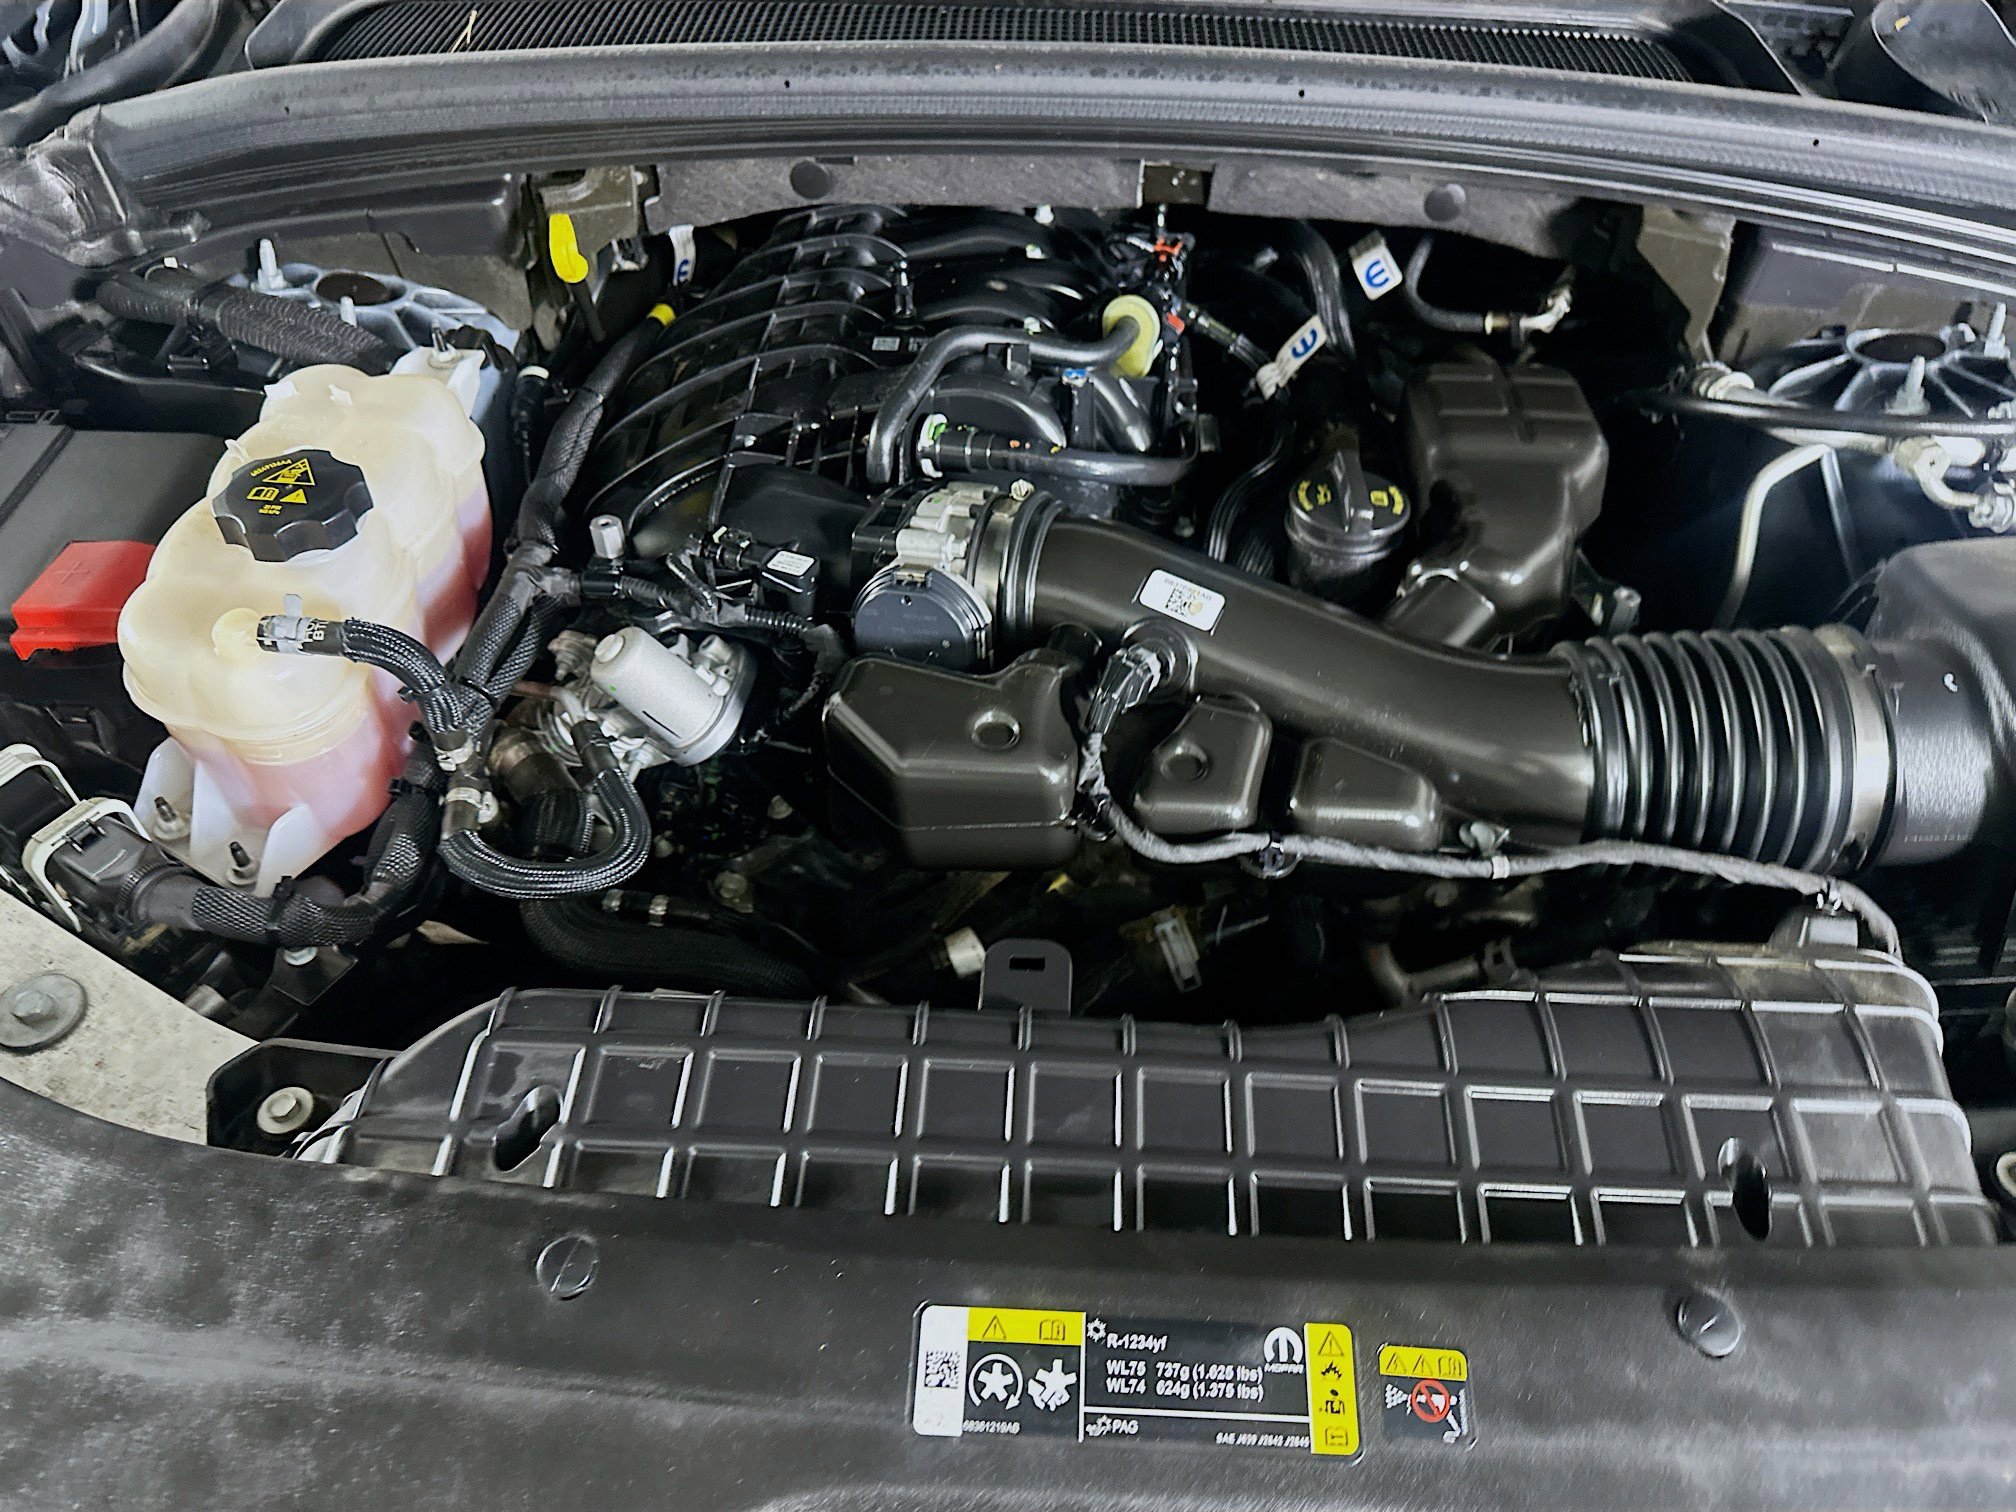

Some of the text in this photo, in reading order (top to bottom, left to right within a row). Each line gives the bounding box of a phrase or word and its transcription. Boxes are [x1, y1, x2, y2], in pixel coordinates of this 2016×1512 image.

[1106, 1359, 1264, 1385] WL75 737g (1.625 lbs)
[1106, 1377, 1264, 1403] WL74 624g (1.375 lbs)
[1112, 1418, 1139, 1435] PAG
